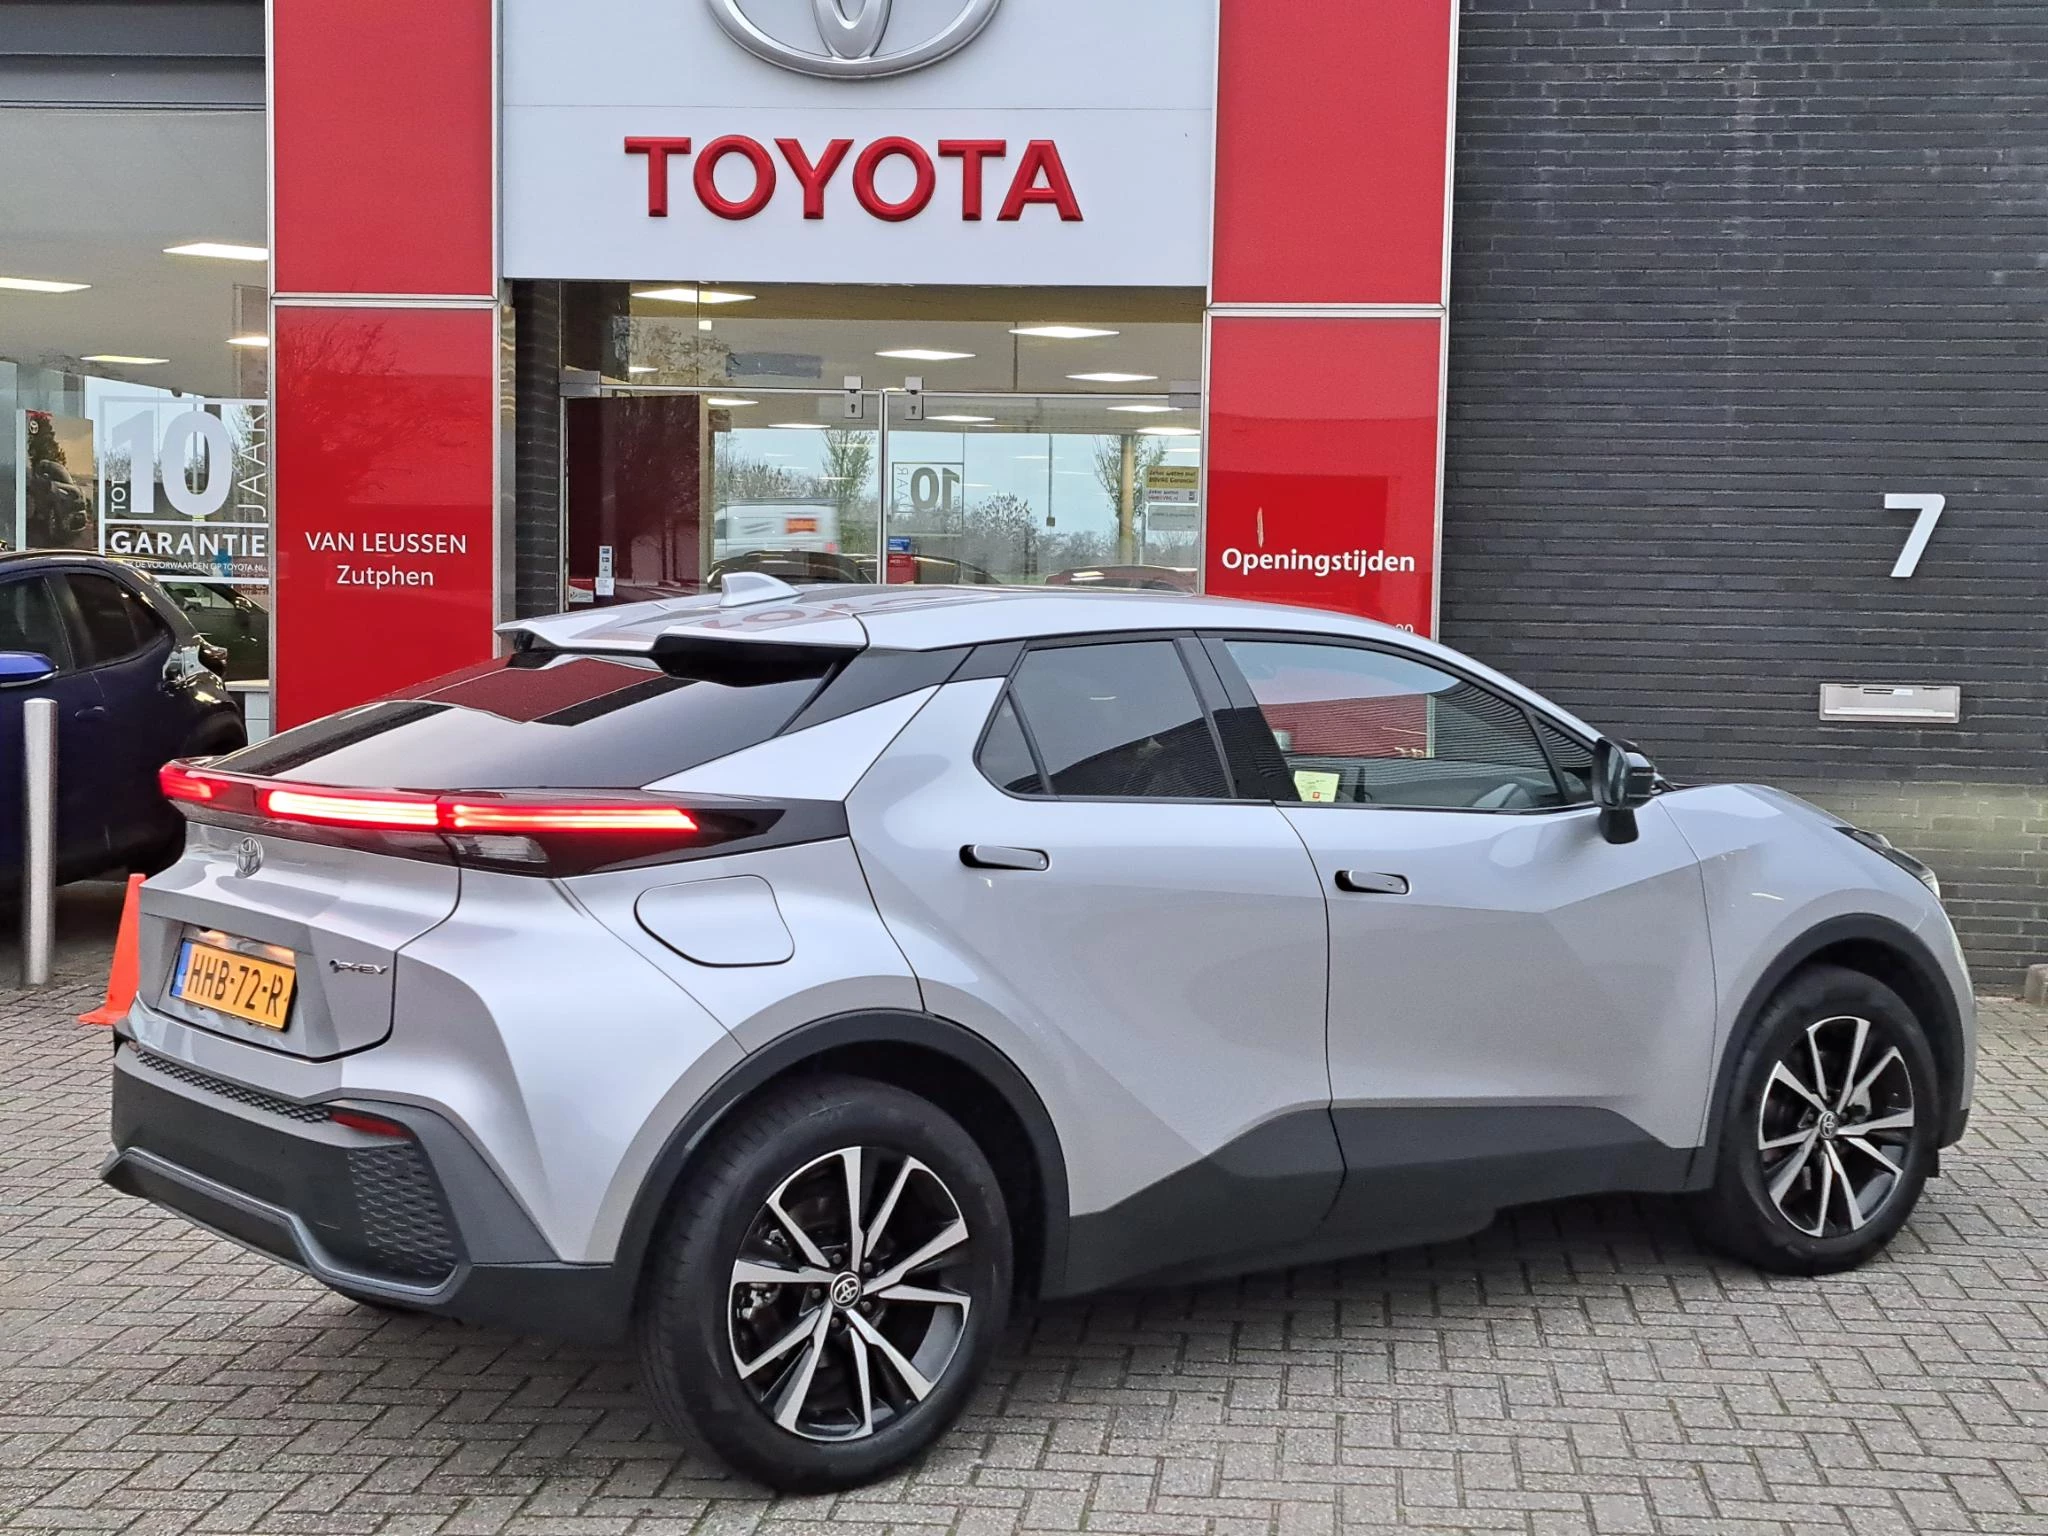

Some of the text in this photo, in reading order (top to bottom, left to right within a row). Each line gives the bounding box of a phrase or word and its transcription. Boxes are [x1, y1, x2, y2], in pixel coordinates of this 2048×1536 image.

[624, 134, 1084, 222] TOYOTA
[112, 410, 233, 517] 10
[237, 412, 267, 519] JAAR
[111, 478, 127, 513] TOT
[110, 531, 266, 557] GARANTIE
[305, 532, 467, 554] VAN LEUSSEN
[1884, 493, 1946, 578] 7
[147, 562, 209, 571] VOORWAARDEN
[336, 564, 434, 590] Zutphen
[1221, 548, 1416, 577] Openingstijden
[186, 953, 284, 1018] HHB-72-R
